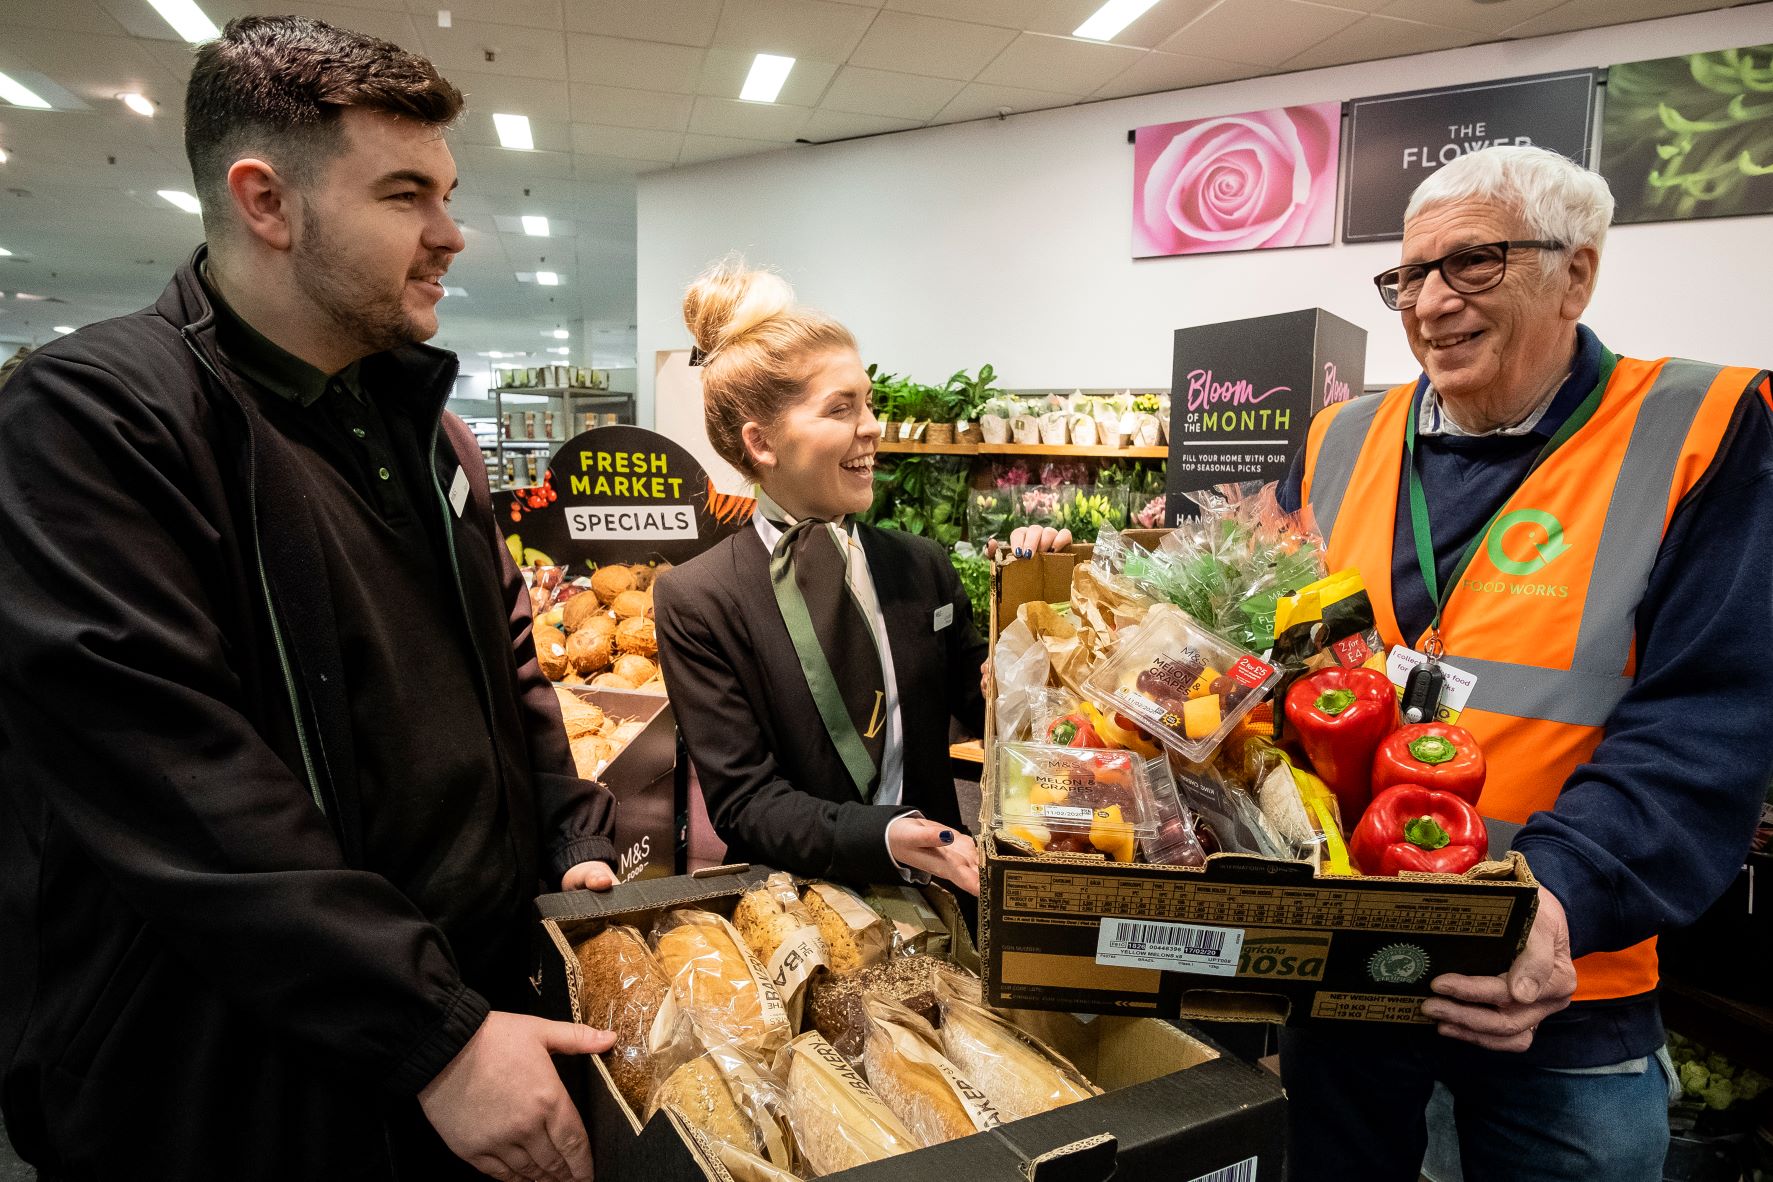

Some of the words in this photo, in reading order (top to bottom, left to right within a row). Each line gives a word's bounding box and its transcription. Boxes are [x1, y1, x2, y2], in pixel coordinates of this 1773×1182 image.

[1448, 122, 1486, 139] THE
[1187, 369, 1292, 411] Bloom
[1324, 362, 1350, 406] Bloom
[1184, 424, 1200, 433] THE
[1203, 409, 1290, 432] MONTH
[1187, 413, 1199, 422] OF
[580, 451, 668, 474] FRESH
[1182, 454, 1197, 462] FILL
[1199, 454, 1218, 462] YOUR
[1220, 454, 1243, 463] HOME
[1245, 455, 1265, 463] WITH
[1267, 455, 1286, 463] OUR
[1182, 464, 1195, 472] TOP
[1197, 464, 1235, 473] SEASONAL
[1237, 464, 1262, 473] PICKS
[570, 475, 683, 499] MARKET
[573, 511, 689, 532] SPECIALS
[1462, 579, 1506, 593] FOOD
[1510, 583, 1569, 598] WORKS
[1339, 642, 1348, 652] 2
[1347, 640, 1359, 649] for
[1181, 646, 1209, 667] M&S
[1348, 651, 1363, 663] £4
[1153, 657, 1191, 684] MELON
[1191, 682, 1201, 691] &
[1239, 658, 1248, 667] 2
[1254, 666, 1268, 676] £5
[1396, 653, 1422, 665] collect
[1452, 676, 1471, 687] food
[1397, 664, 1409, 672] for
[1149, 667, 1192, 696] GRAPES
[1048, 761, 1080, 769] M&S
[1036, 776, 1082, 786] MELON
[1087, 778, 1096, 786] &
[1040, 783, 1094, 793] GRAPES
[621, 835, 650, 874] M&S
[627, 863, 644, 881] FOOD
[797, 941, 814, 957] THE
[1185, 947, 1216, 956] 17/02/20
[768, 1002, 784, 1010] THE
[809, 1041, 870, 1092] BAKERY
